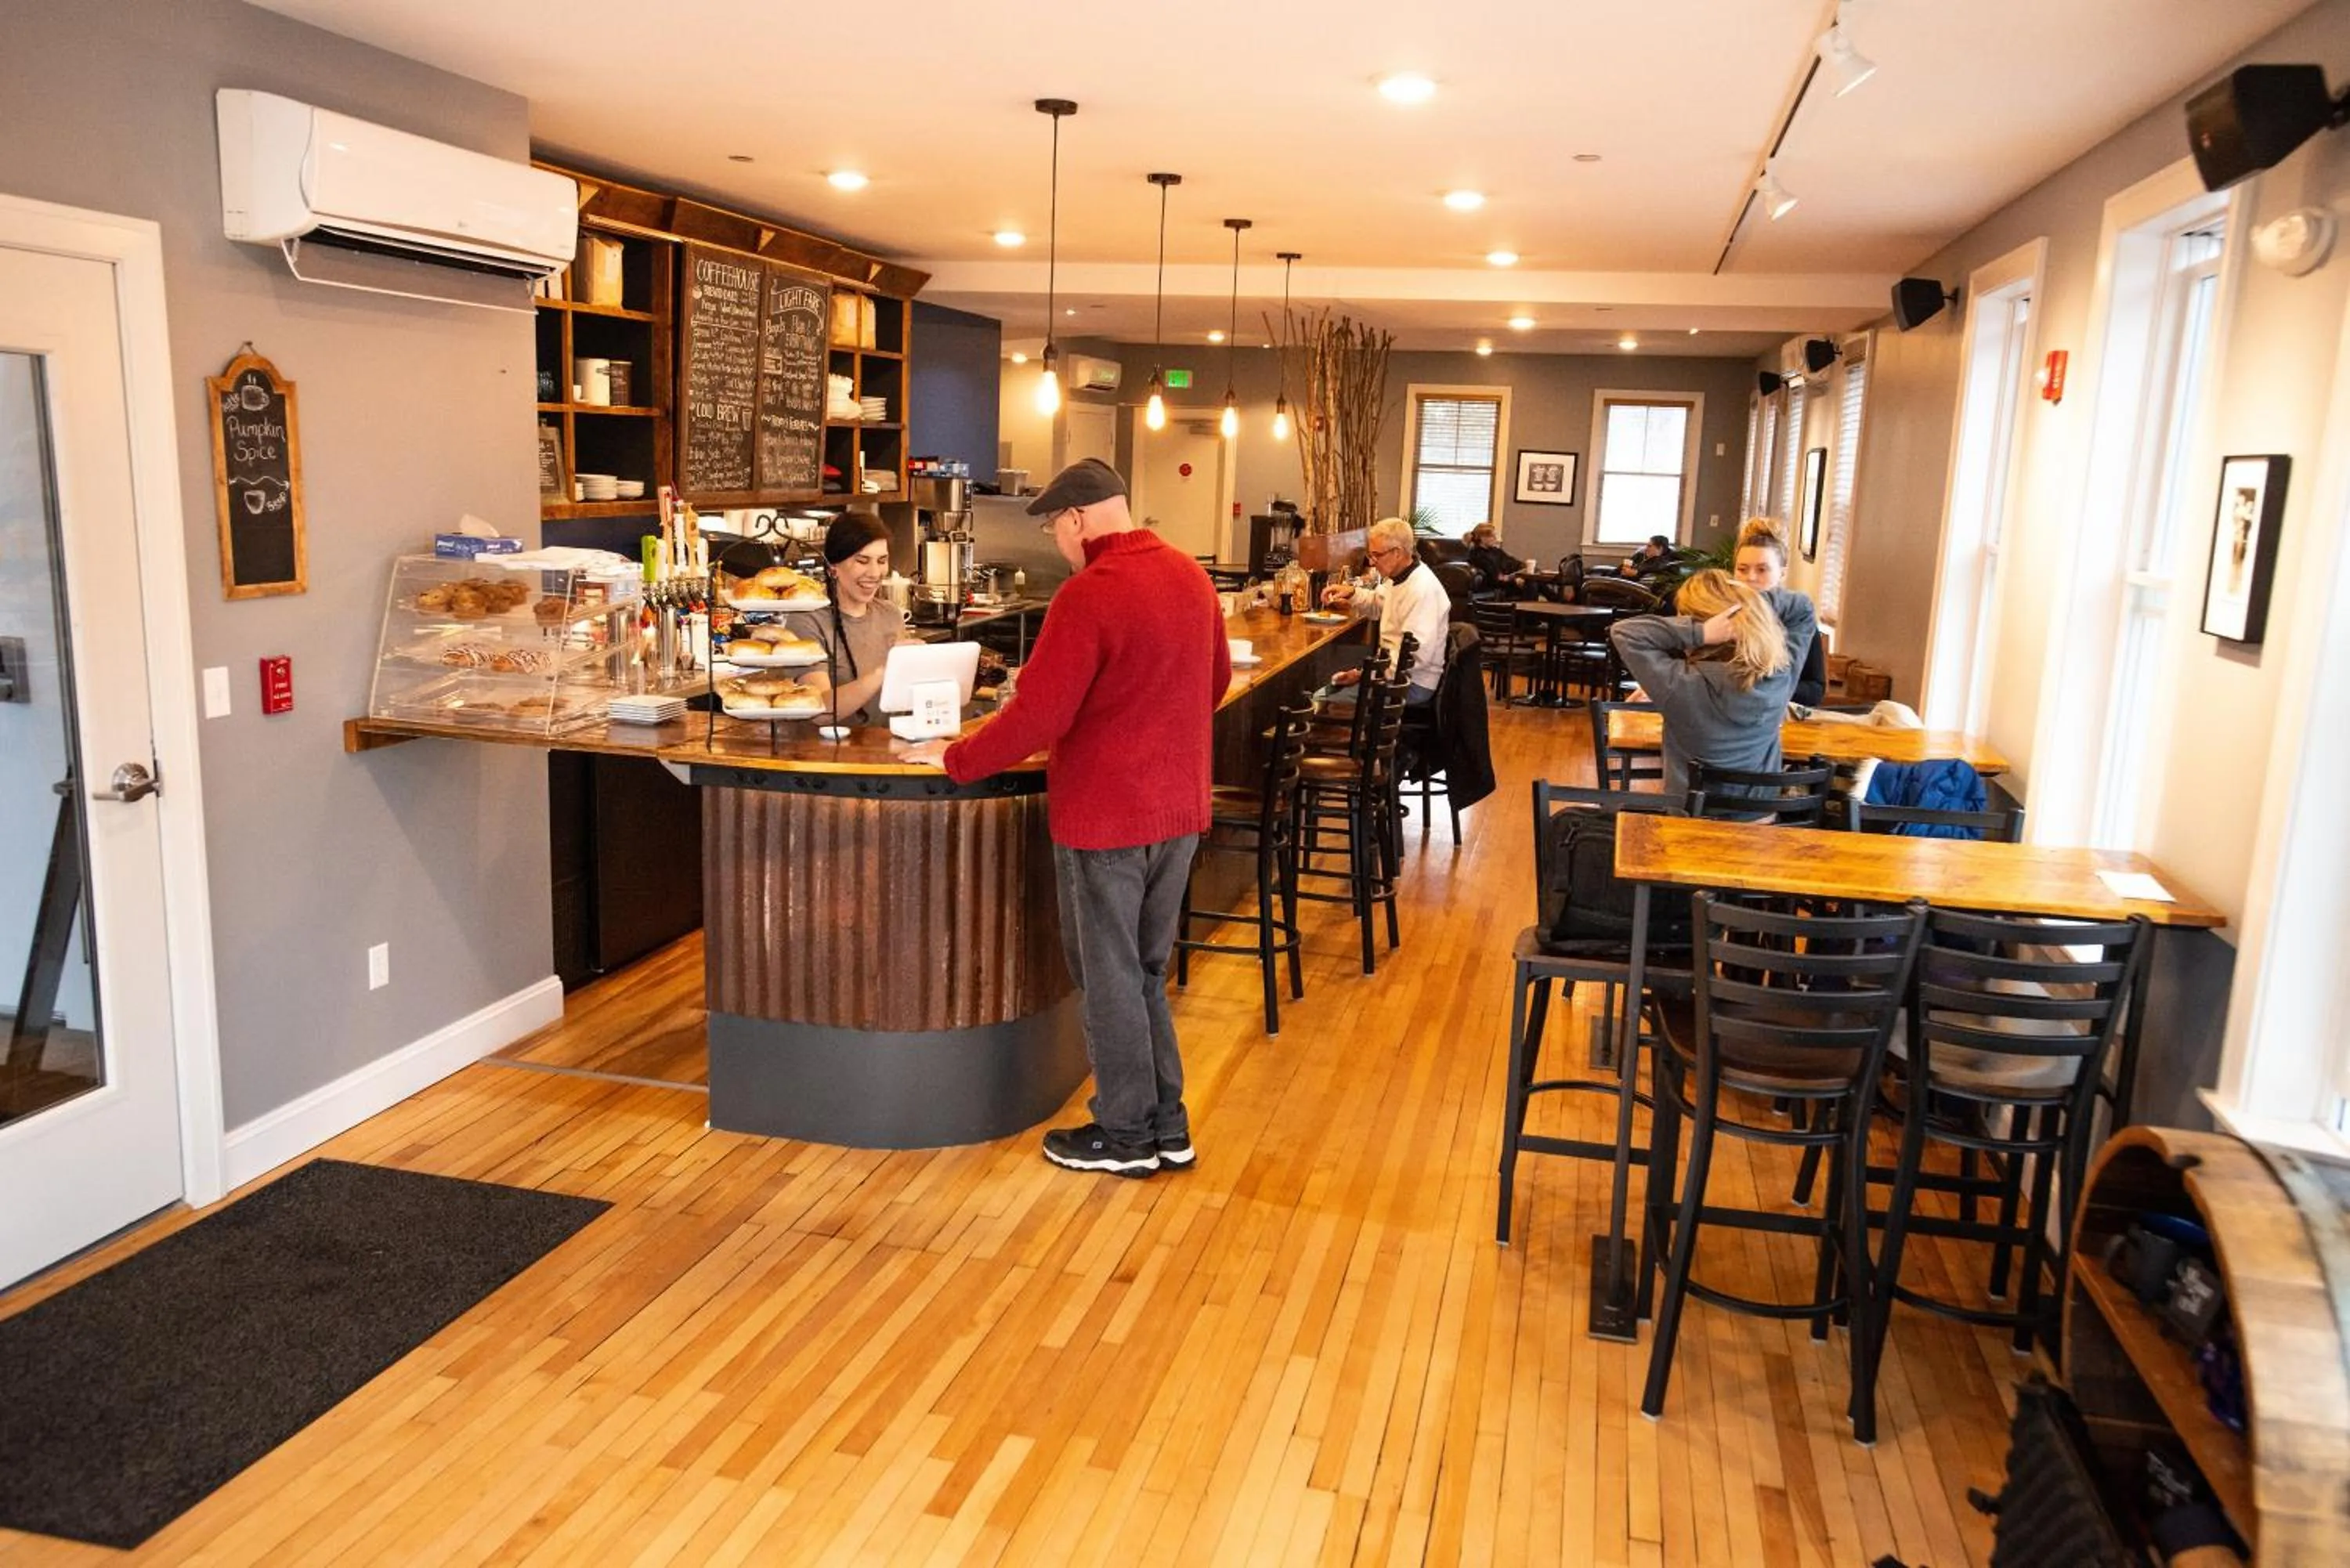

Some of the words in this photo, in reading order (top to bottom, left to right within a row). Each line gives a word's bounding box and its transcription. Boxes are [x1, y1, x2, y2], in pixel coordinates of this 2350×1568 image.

[779, 290, 802, 309] LIGHT
[226, 415, 286, 443] Pumpkin
[233, 441, 277, 468] Spice
